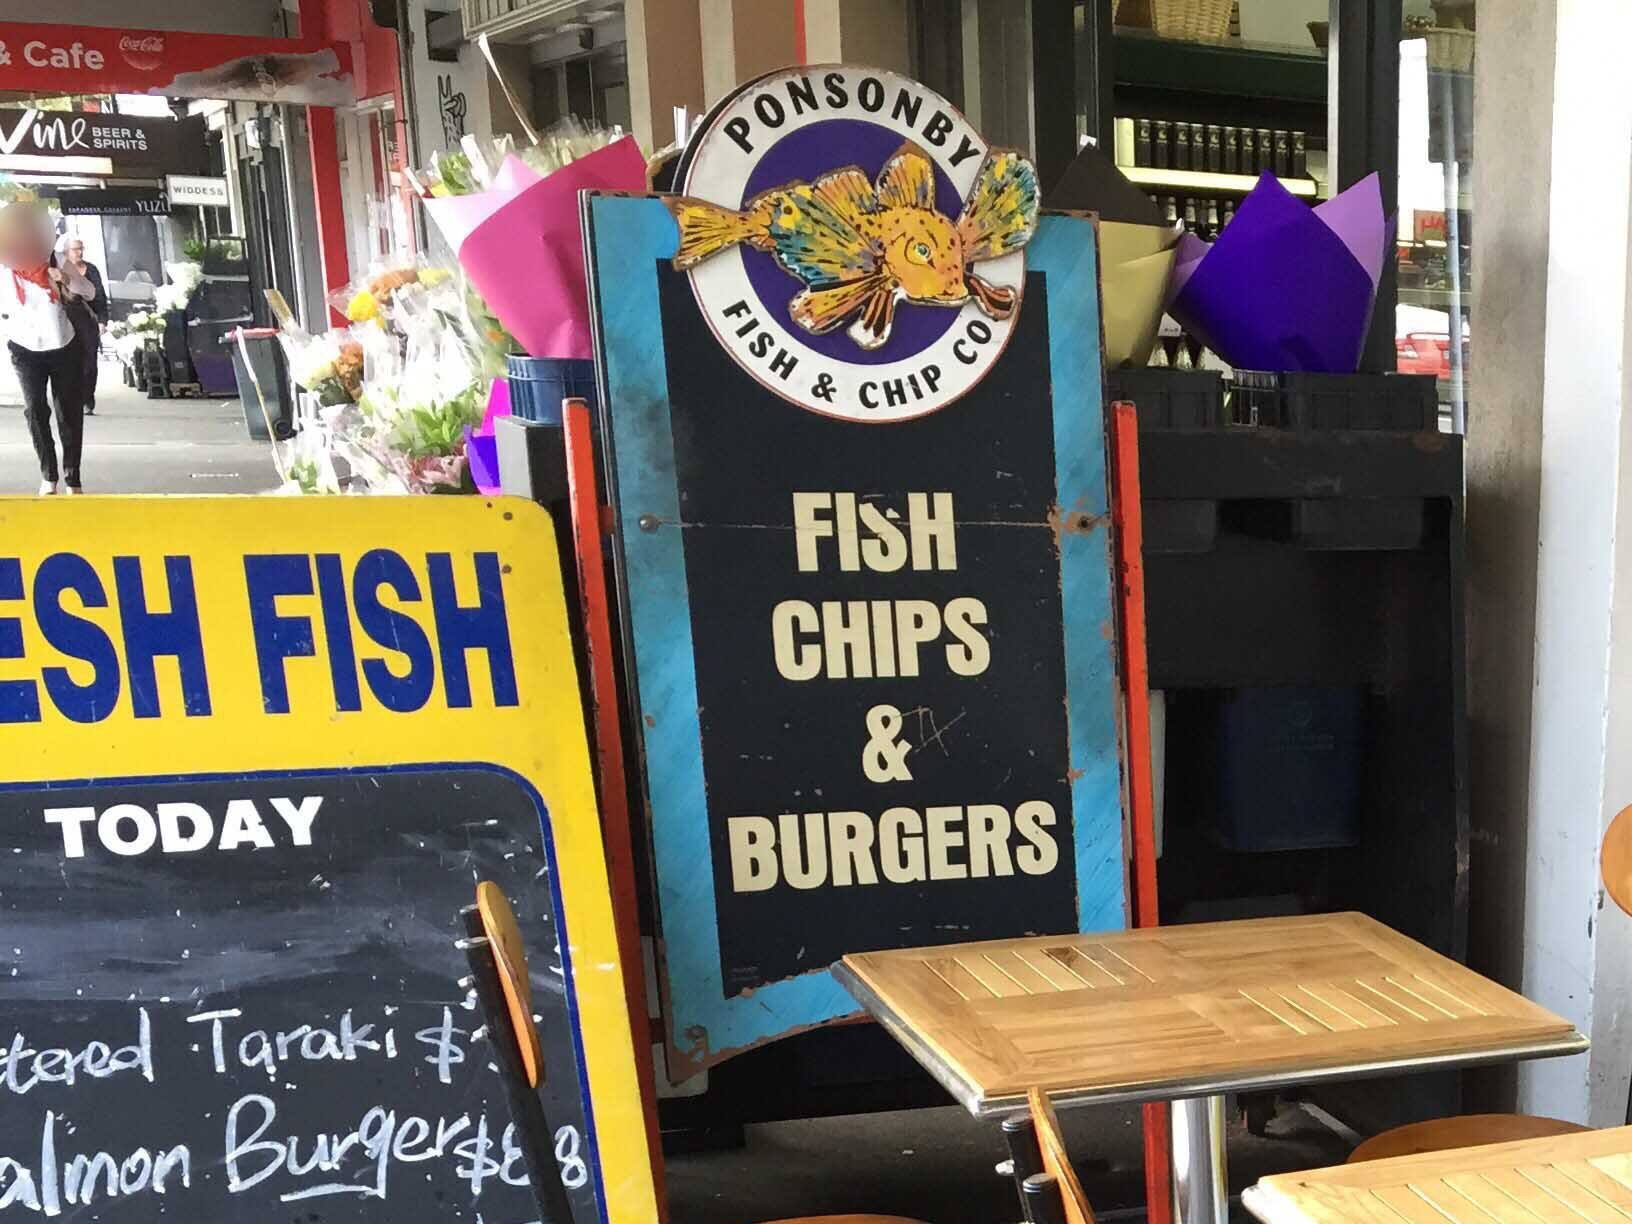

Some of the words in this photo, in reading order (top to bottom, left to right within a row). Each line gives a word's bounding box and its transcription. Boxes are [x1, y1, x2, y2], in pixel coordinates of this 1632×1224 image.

[24, 40, 104, 70] Cafe
[92, 127, 131, 138] BEER
[135, 128, 146, 139] &
[93, 138, 148, 150] SPIRITS
[723, 72, 980, 168] PONSONBY
[722, 299, 799, 381] FISH
[811, 371, 838, 403] &
[858, 363, 944, 409] CHIP
[792, 492, 958, 573] FISH
[243, 548, 519, 714] FISH
[772, 597, 991, 681] CHIPS
[862, 704, 913, 783] &
[45, 796, 323, 858] TODAY
[728, 800, 1059, 892] BURGERS
[0, 1006, 154, 1094] tered
[187, 1007, 397, 1075] Taraki
[225, 1094, 471, 1200] Burger
